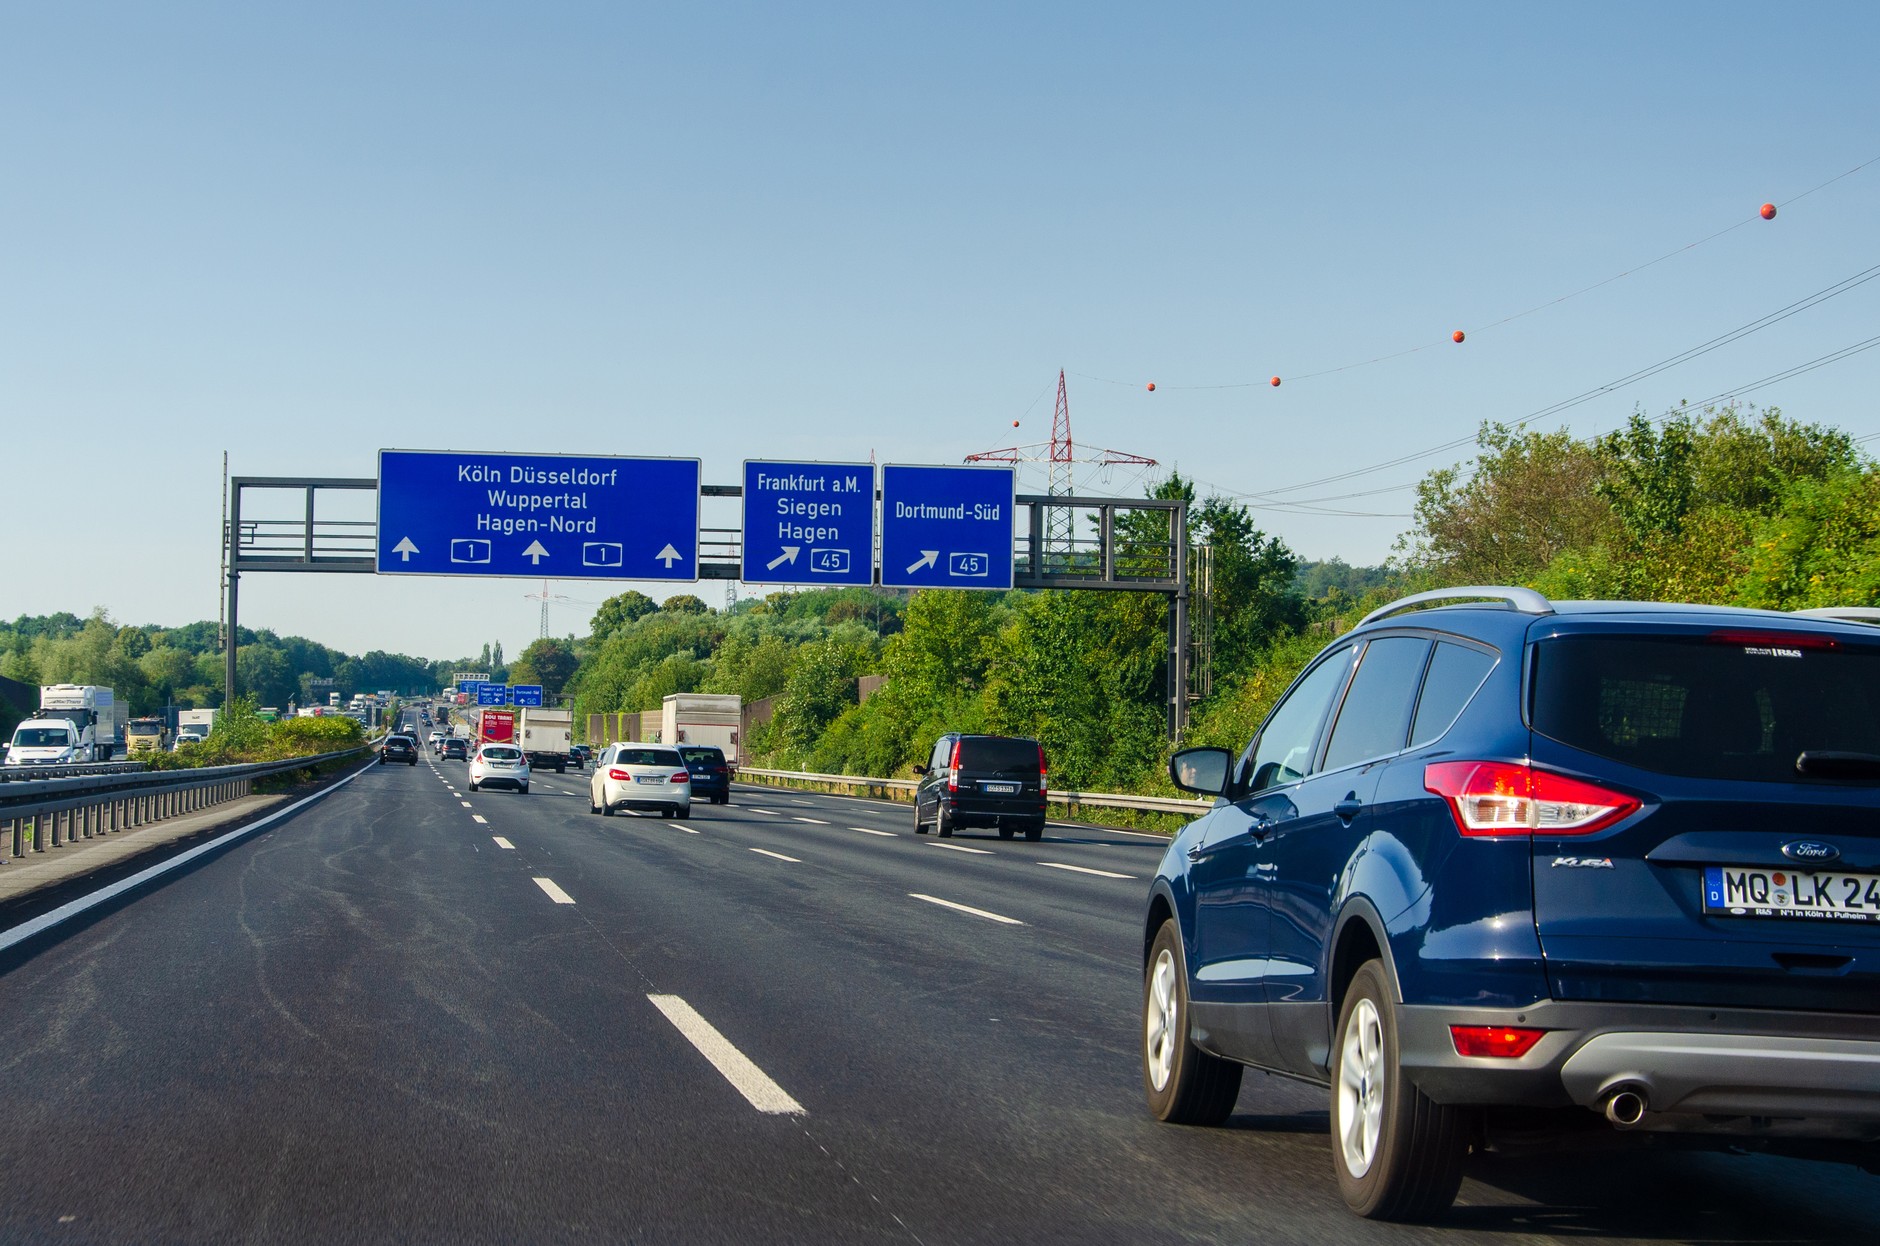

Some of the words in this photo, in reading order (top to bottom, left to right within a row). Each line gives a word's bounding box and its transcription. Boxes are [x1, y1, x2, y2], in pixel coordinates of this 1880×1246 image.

[458, 465, 501, 483] Köln
[510, 466, 617, 486] Düsseldorf
[757, 473, 825, 492] Frankfurt
[832, 475, 861, 493] a.M.
[487, 490, 588, 512] Wuppertal
[776, 497, 842, 520] Siegen
[895, 502, 1000, 521] Dortmund-Süd
[477, 513, 596, 536] Hagen-Nord
[778, 522, 839, 544] Hagen
[820, 553, 841, 568] 45
[959, 557, 979, 572] 45
[1777, 648, 1802, 658] R&S
[1796, 842, 1827, 857] Ford
[1551, 857, 1616, 870] KUGA
[1711, 890, 1719, 901] D
[1725, 871, 1770, 904] MQ
[1791, 875, 1836, 907] LK
[1805, 909, 1825, 918] Köln
[1825, 911, 1833, 919] &
[1834, 911, 1867, 920] Pulheim
